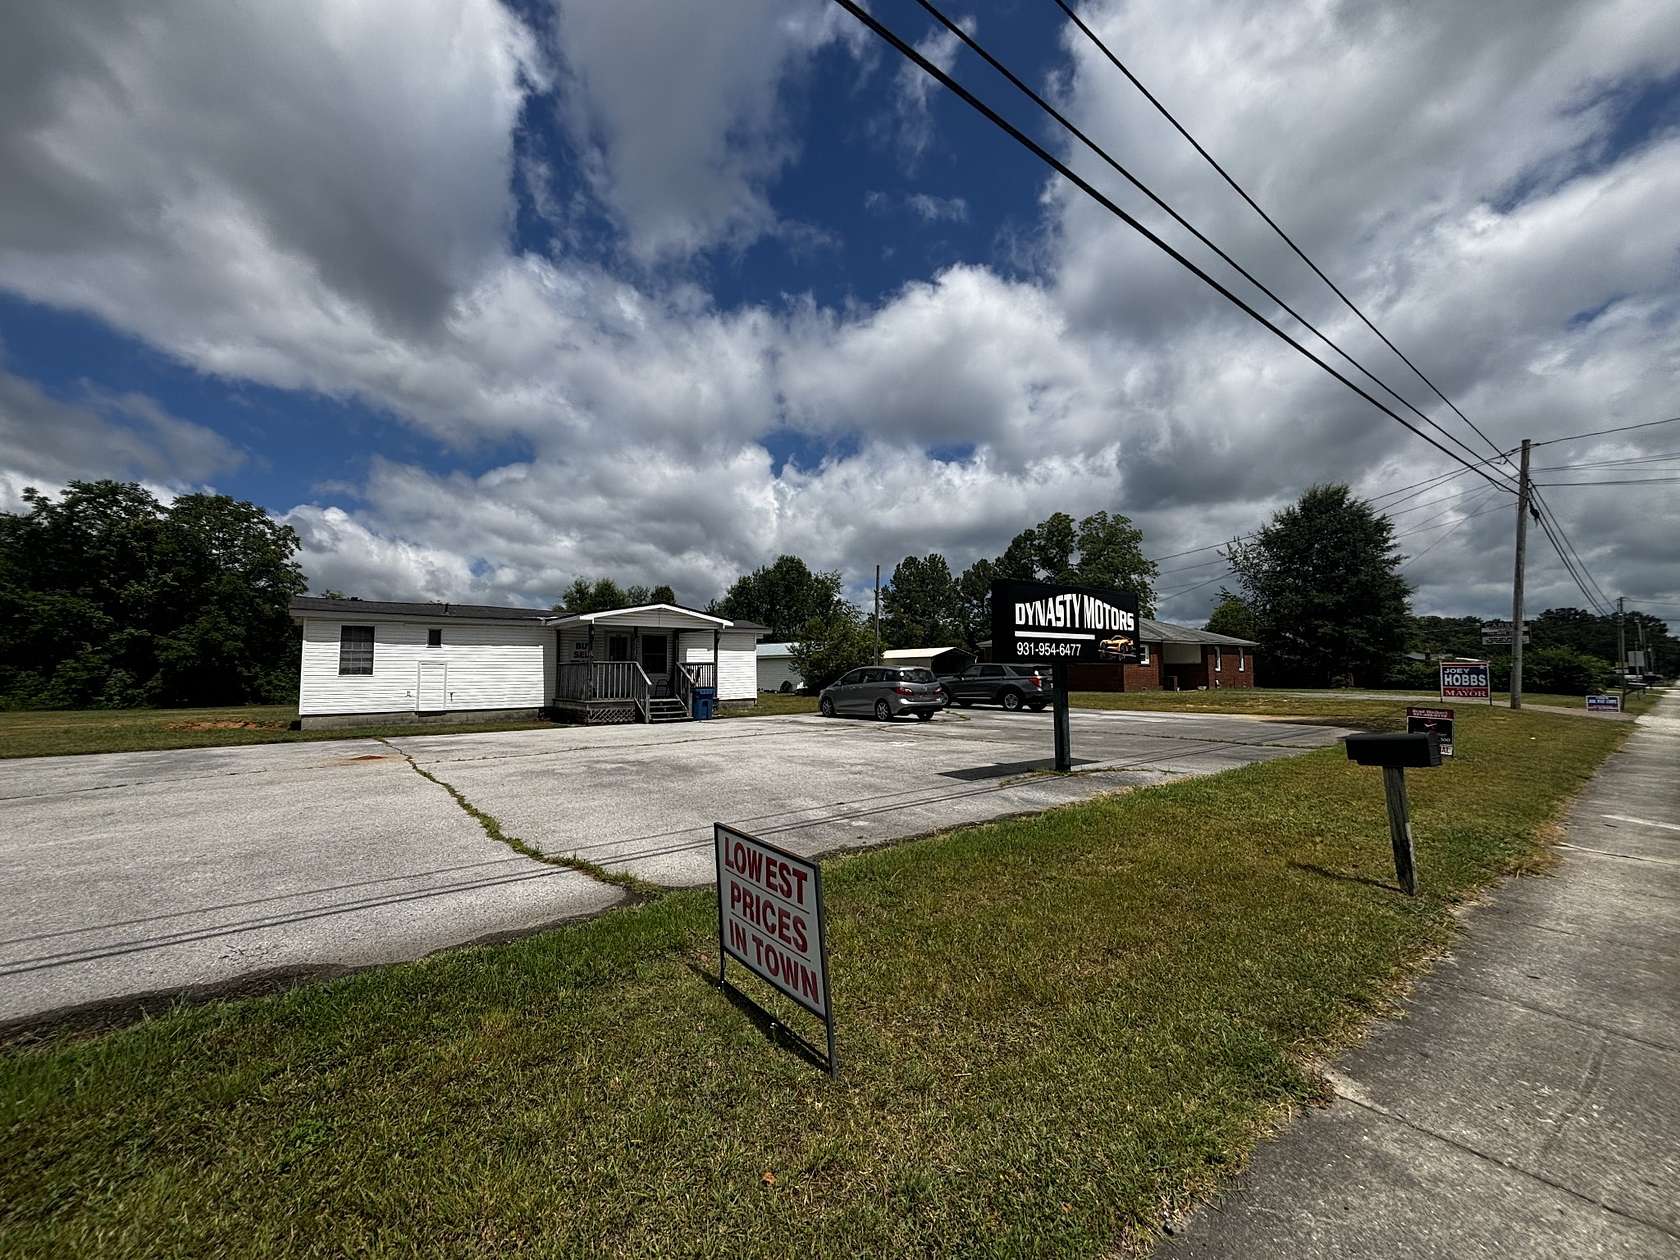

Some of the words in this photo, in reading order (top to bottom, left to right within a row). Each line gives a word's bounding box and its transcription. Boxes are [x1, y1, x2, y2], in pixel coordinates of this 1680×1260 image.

[1015, 594, 1081, 628] DYNASTY
[1083, 595, 1135, 631] MOTORS
[1016, 642, 1081, 656] 931-954-6477
[1444, 674, 1486, 686] HOBBS
[724, 837, 808, 905] LOWEST
[730, 880, 808, 953] PRICES
[729, 919, 748, 956] IN
[751, 933, 820, 1004] TOWN
